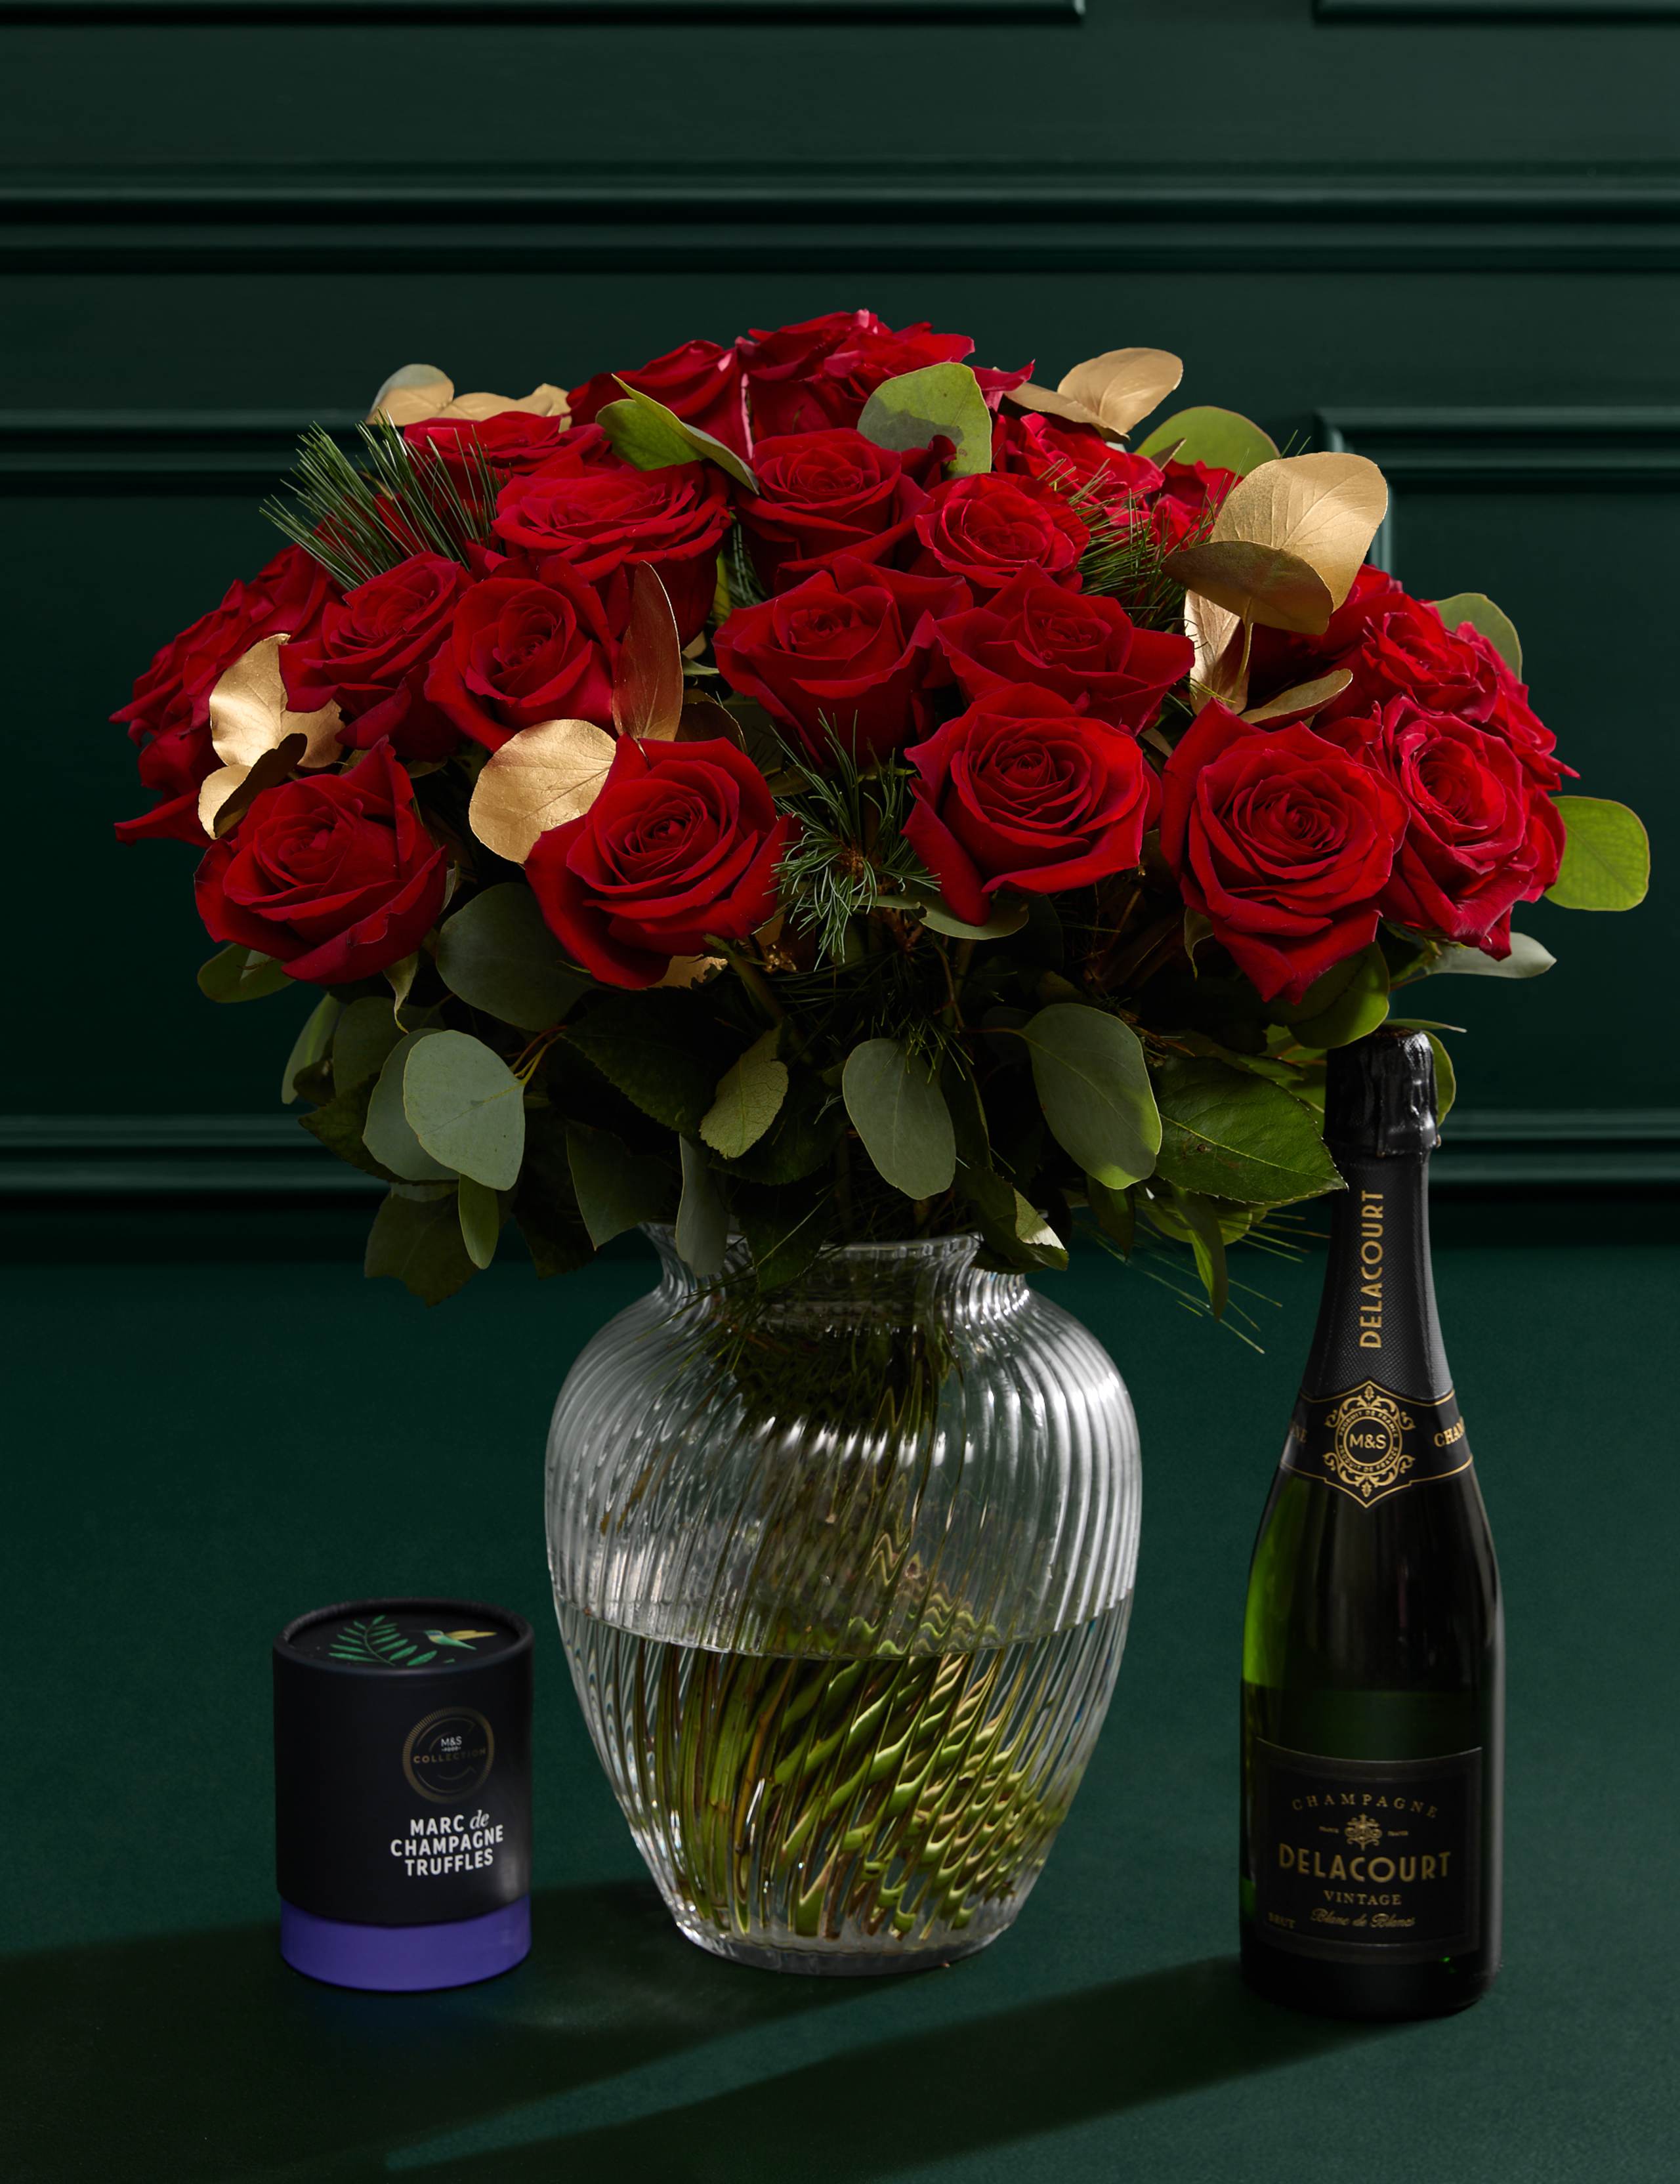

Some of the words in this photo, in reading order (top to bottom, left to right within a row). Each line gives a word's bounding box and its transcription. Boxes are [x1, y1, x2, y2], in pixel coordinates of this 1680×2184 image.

[1360, 1190, 1383, 1348] DELACOURT
[1349, 1433, 1387, 1450] M&S
[440, 1735, 462, 1747] M&S
[413, 1748, 486, 1764] COLLECTION
[1292, 1792, 1438, 1818] CHAMPAGNE
[410, 1814, 465, 1836] MARC
[469, 1809, 490, 1830] de
[390, 1824, 504, 1857] CHAMPAGNE
[404, 1848, 494, 1877] TRUFFLES
[1278, 1842, 1451, 1883] DELACOURT
[1323, 1889, 1403, 1906] VINTAGE
